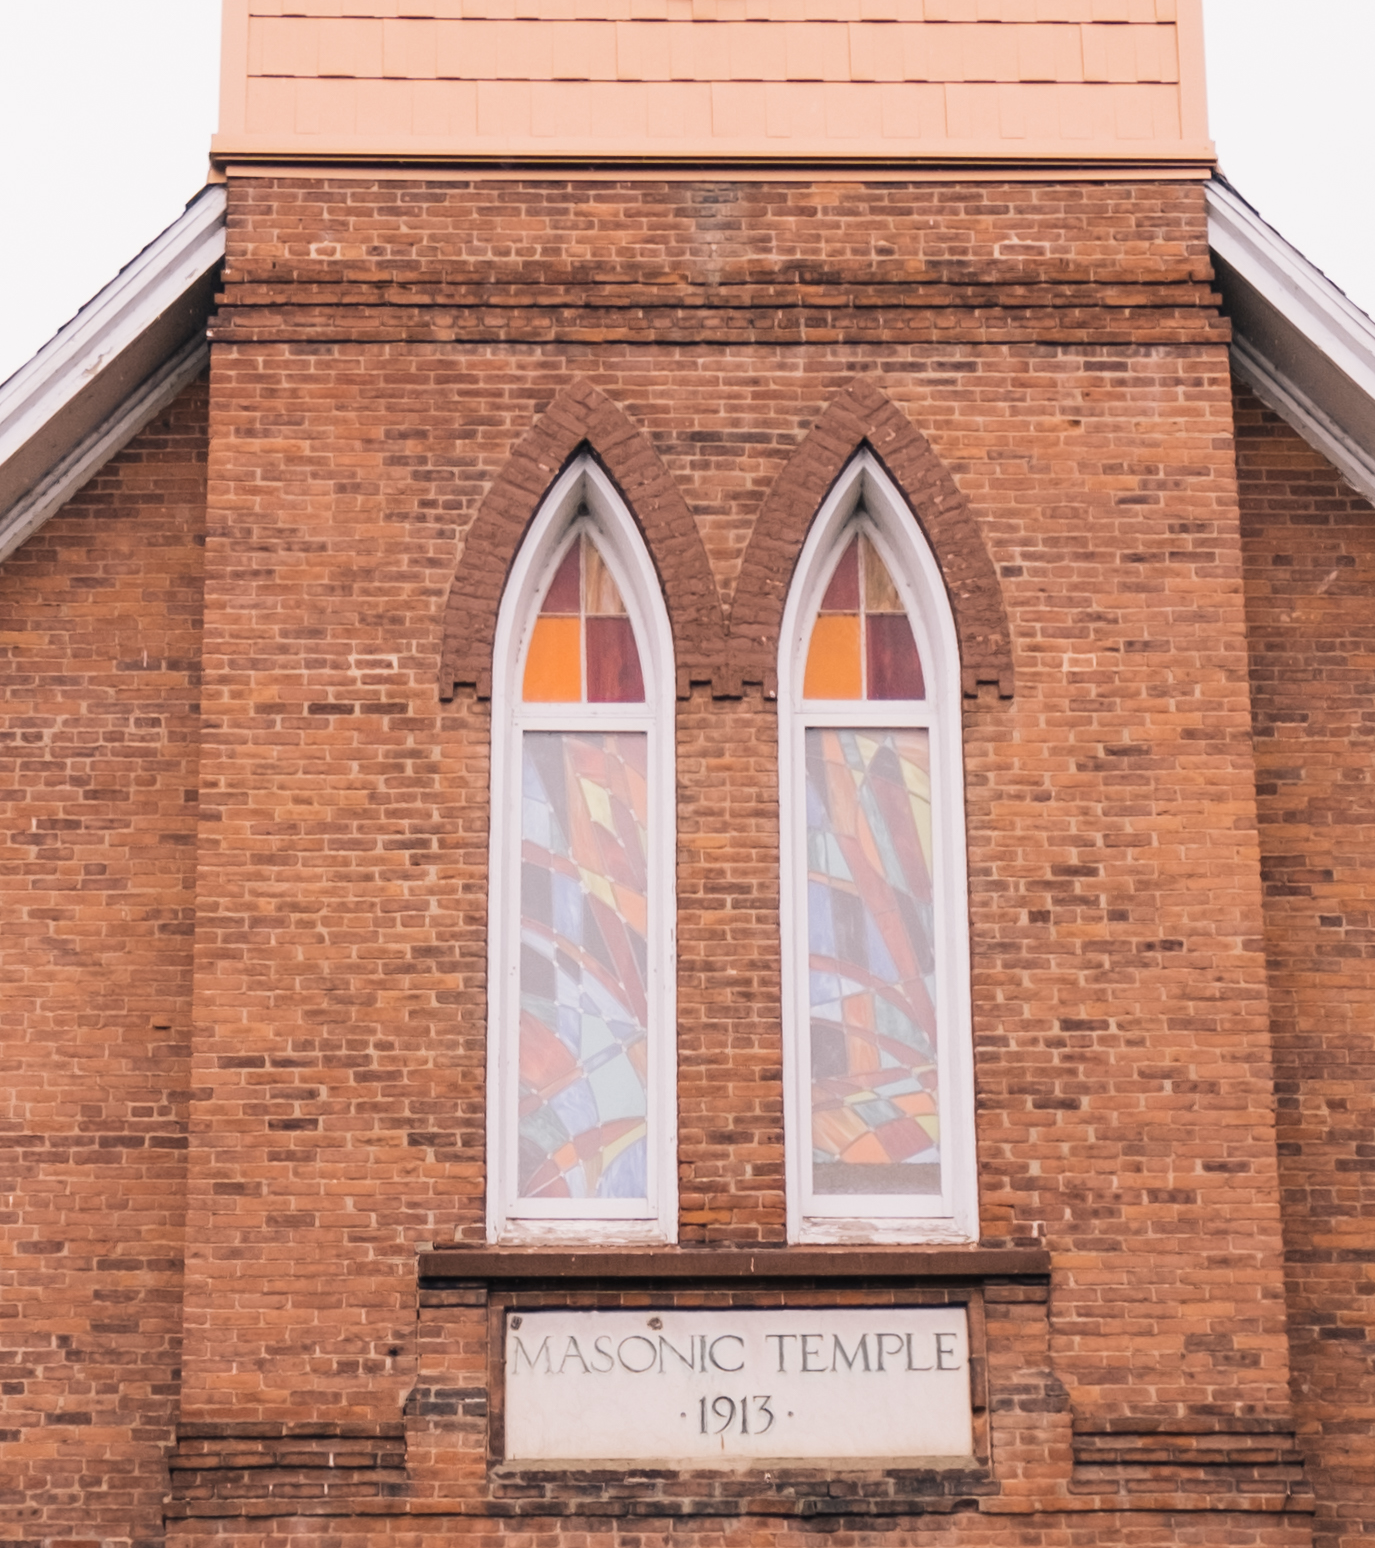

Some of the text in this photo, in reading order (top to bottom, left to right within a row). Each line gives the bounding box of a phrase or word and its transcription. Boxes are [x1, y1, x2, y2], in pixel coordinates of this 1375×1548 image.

[511, 1333, 961, 1375] MASONIC TEMPLE
[697, 1395, 776, 1435] 1913
